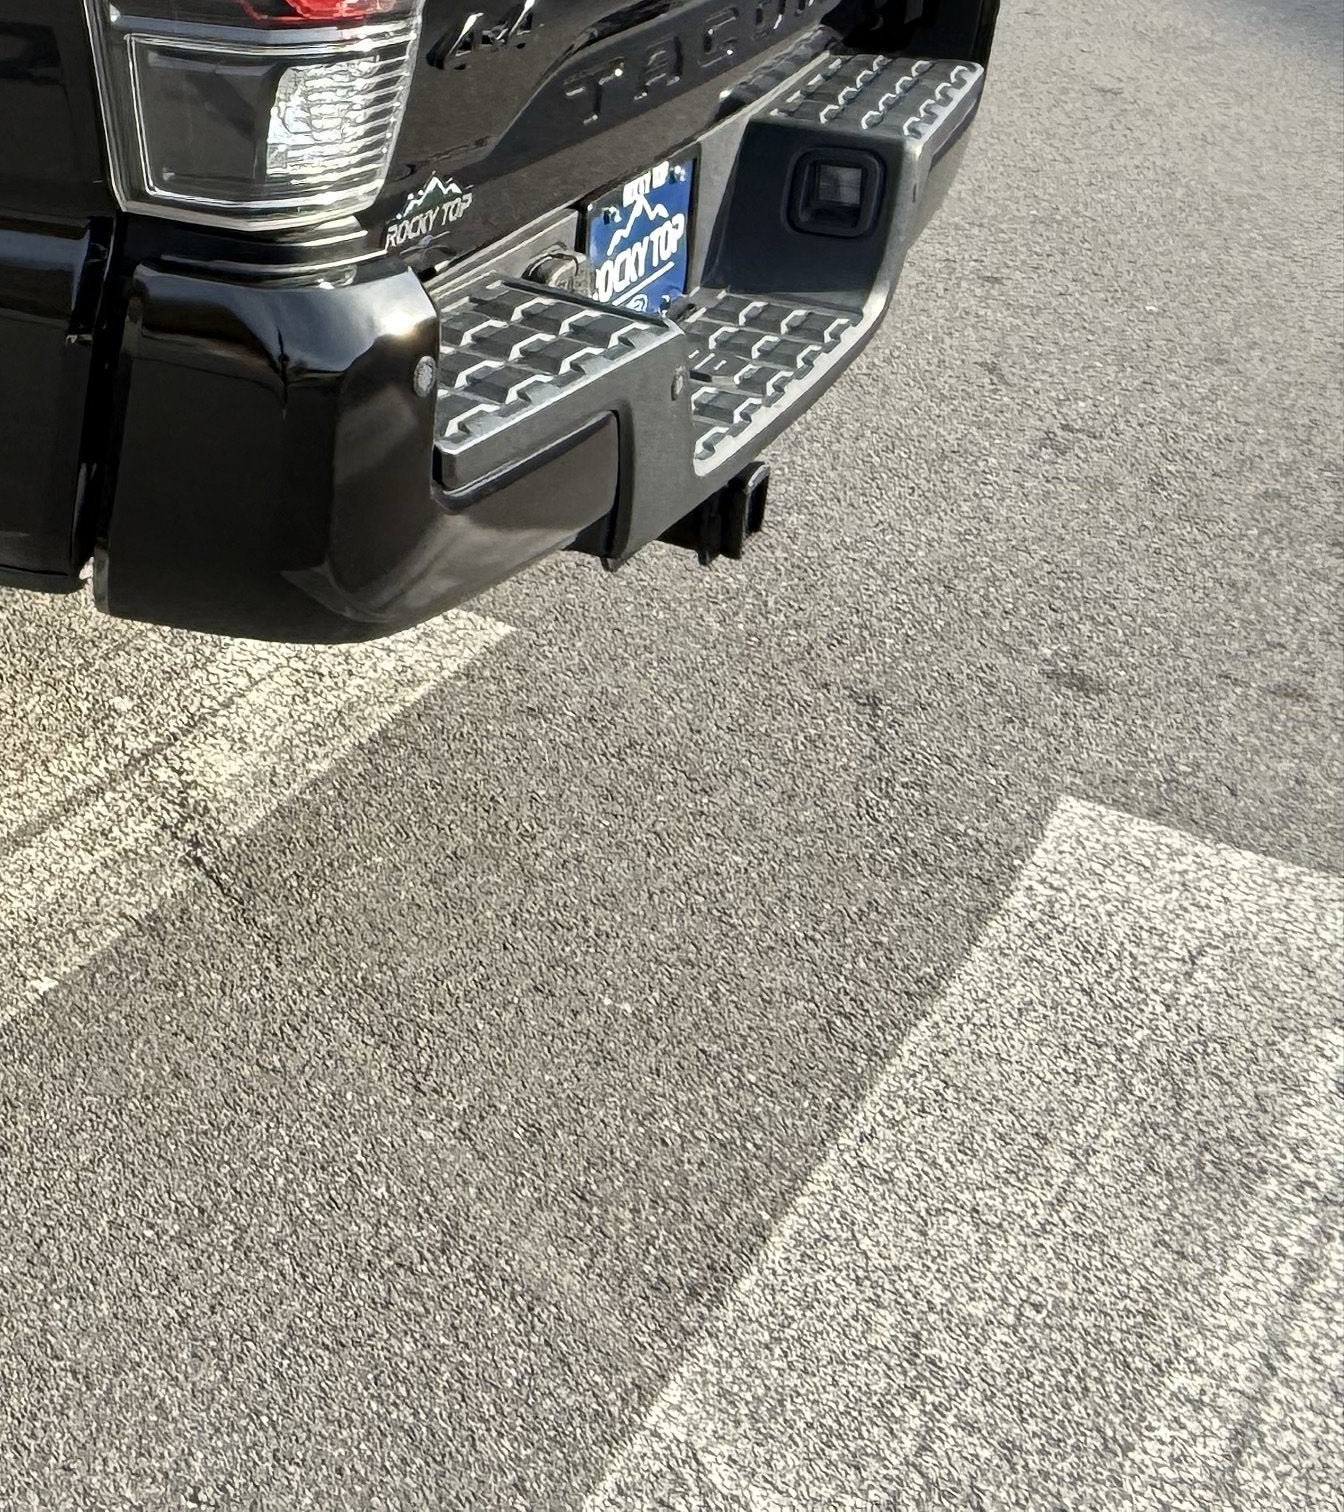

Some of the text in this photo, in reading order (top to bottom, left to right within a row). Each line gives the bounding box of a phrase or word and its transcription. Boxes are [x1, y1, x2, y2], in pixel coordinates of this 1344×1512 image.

[385, 191, 474, 251] ROCKY TOP
[648, 213, 685, 267] TOP
